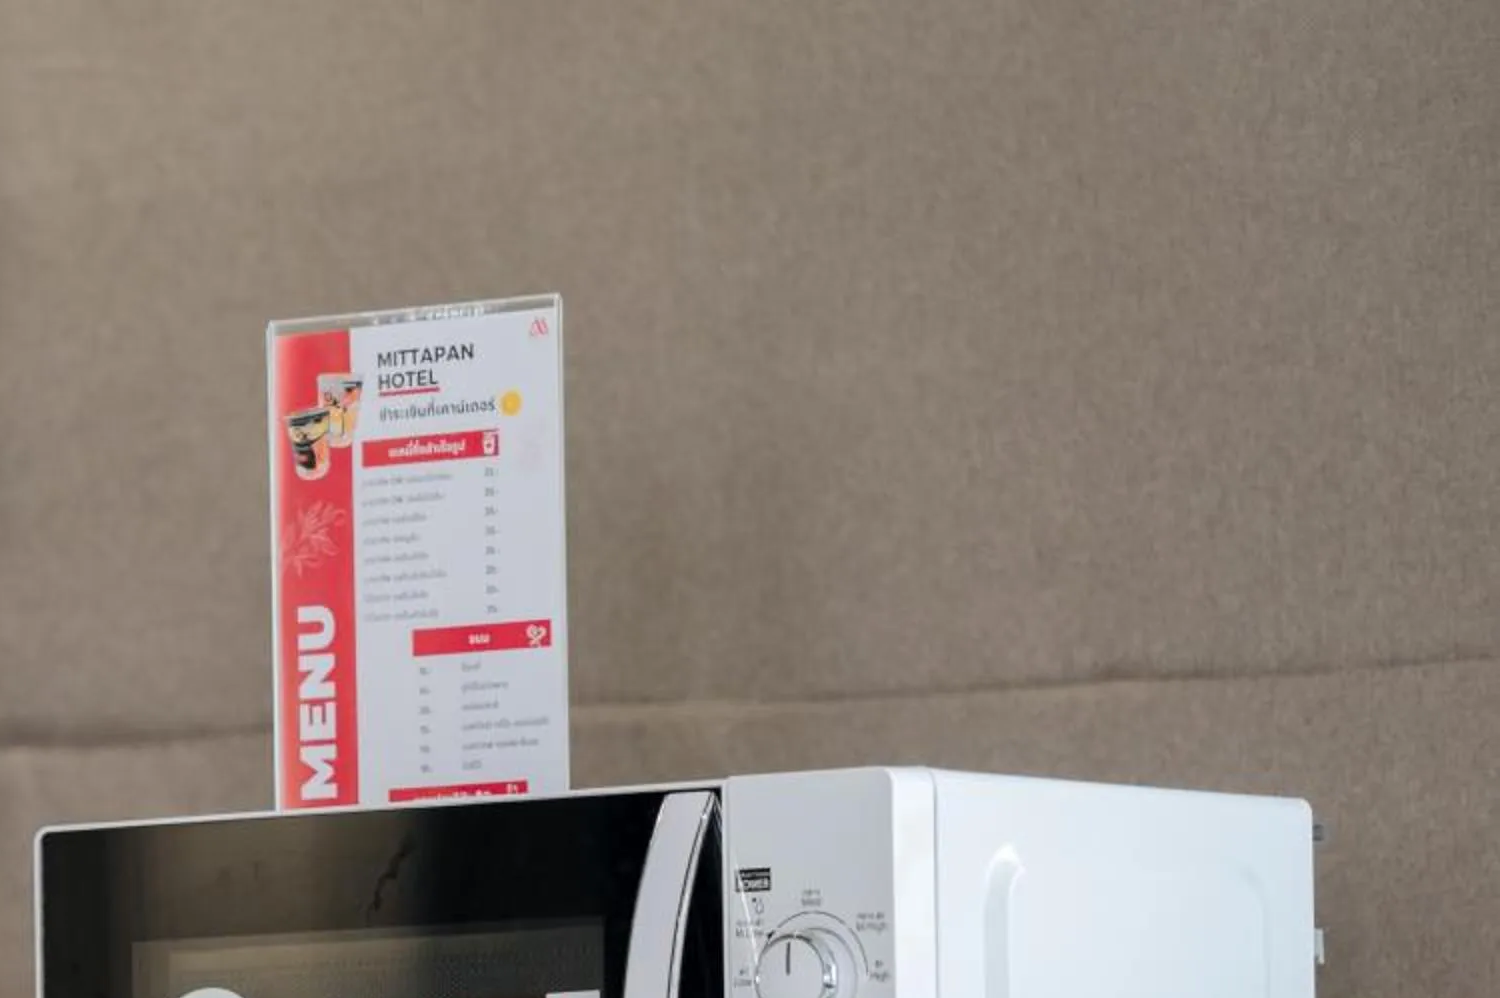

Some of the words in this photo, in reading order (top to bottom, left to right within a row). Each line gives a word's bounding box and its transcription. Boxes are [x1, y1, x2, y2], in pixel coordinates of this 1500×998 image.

[376, 342, 475, 369] MITTAPAN
[378, 368, 439, 391] HOTEL
[297, 604, 338, 801] MENU
